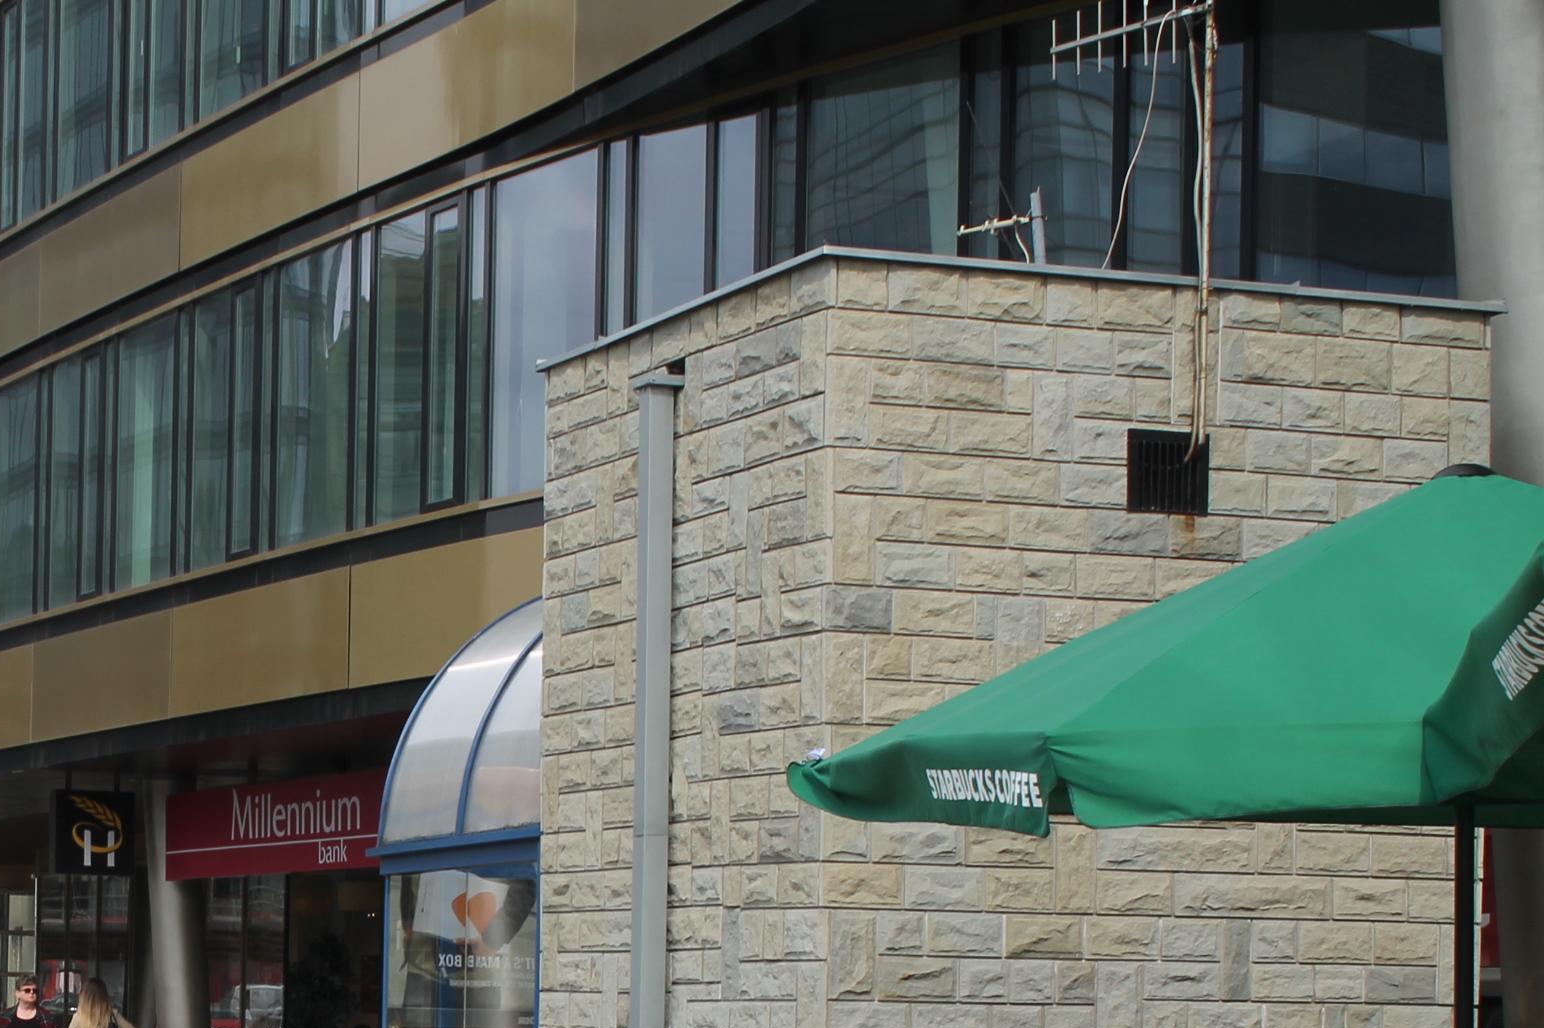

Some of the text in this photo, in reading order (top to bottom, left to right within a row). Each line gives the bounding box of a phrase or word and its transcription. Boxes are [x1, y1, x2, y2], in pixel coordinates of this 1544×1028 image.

[926, 768, 1043, 807] STARBUCKS COFFEE
[231, 788, 361, 840] Millennium
[318, 838, 348, 864] bank
